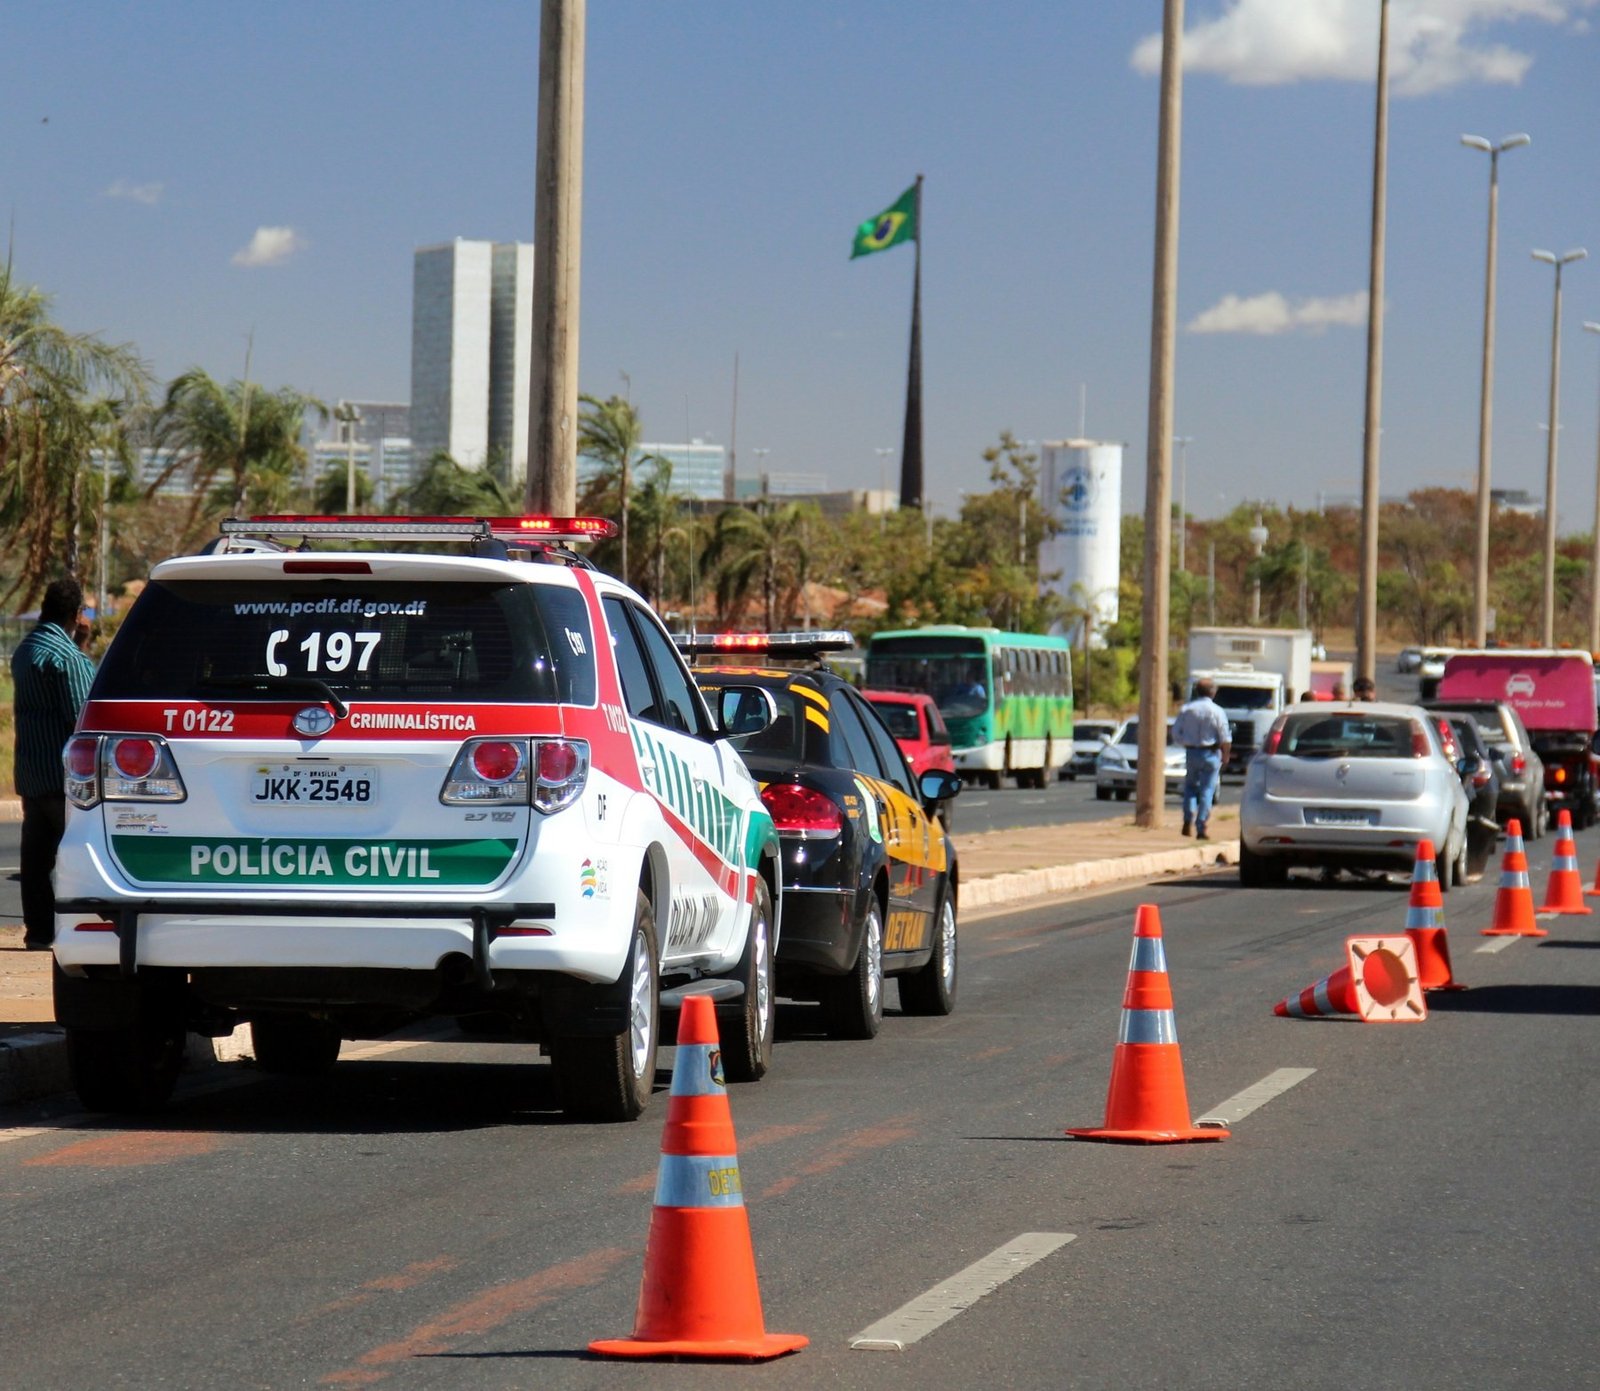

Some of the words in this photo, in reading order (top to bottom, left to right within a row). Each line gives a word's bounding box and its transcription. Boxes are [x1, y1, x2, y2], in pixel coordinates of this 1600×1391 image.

[234, 599, 427, 617] www.pcdf.df.gov.df
[300, 631, 382, 672] 197
[164, 710, 177, 731] T
[183, 710, 235, 732] 0122
[350, 711, 476, 731] CRIMINALÍSTICA
[598, 794, 607, 821] DF
[190, 837, 334, 877] POLÍCIA
[344, 846, 441, 879] CIVIL
[884, 912, 926, 950] DETRAN
